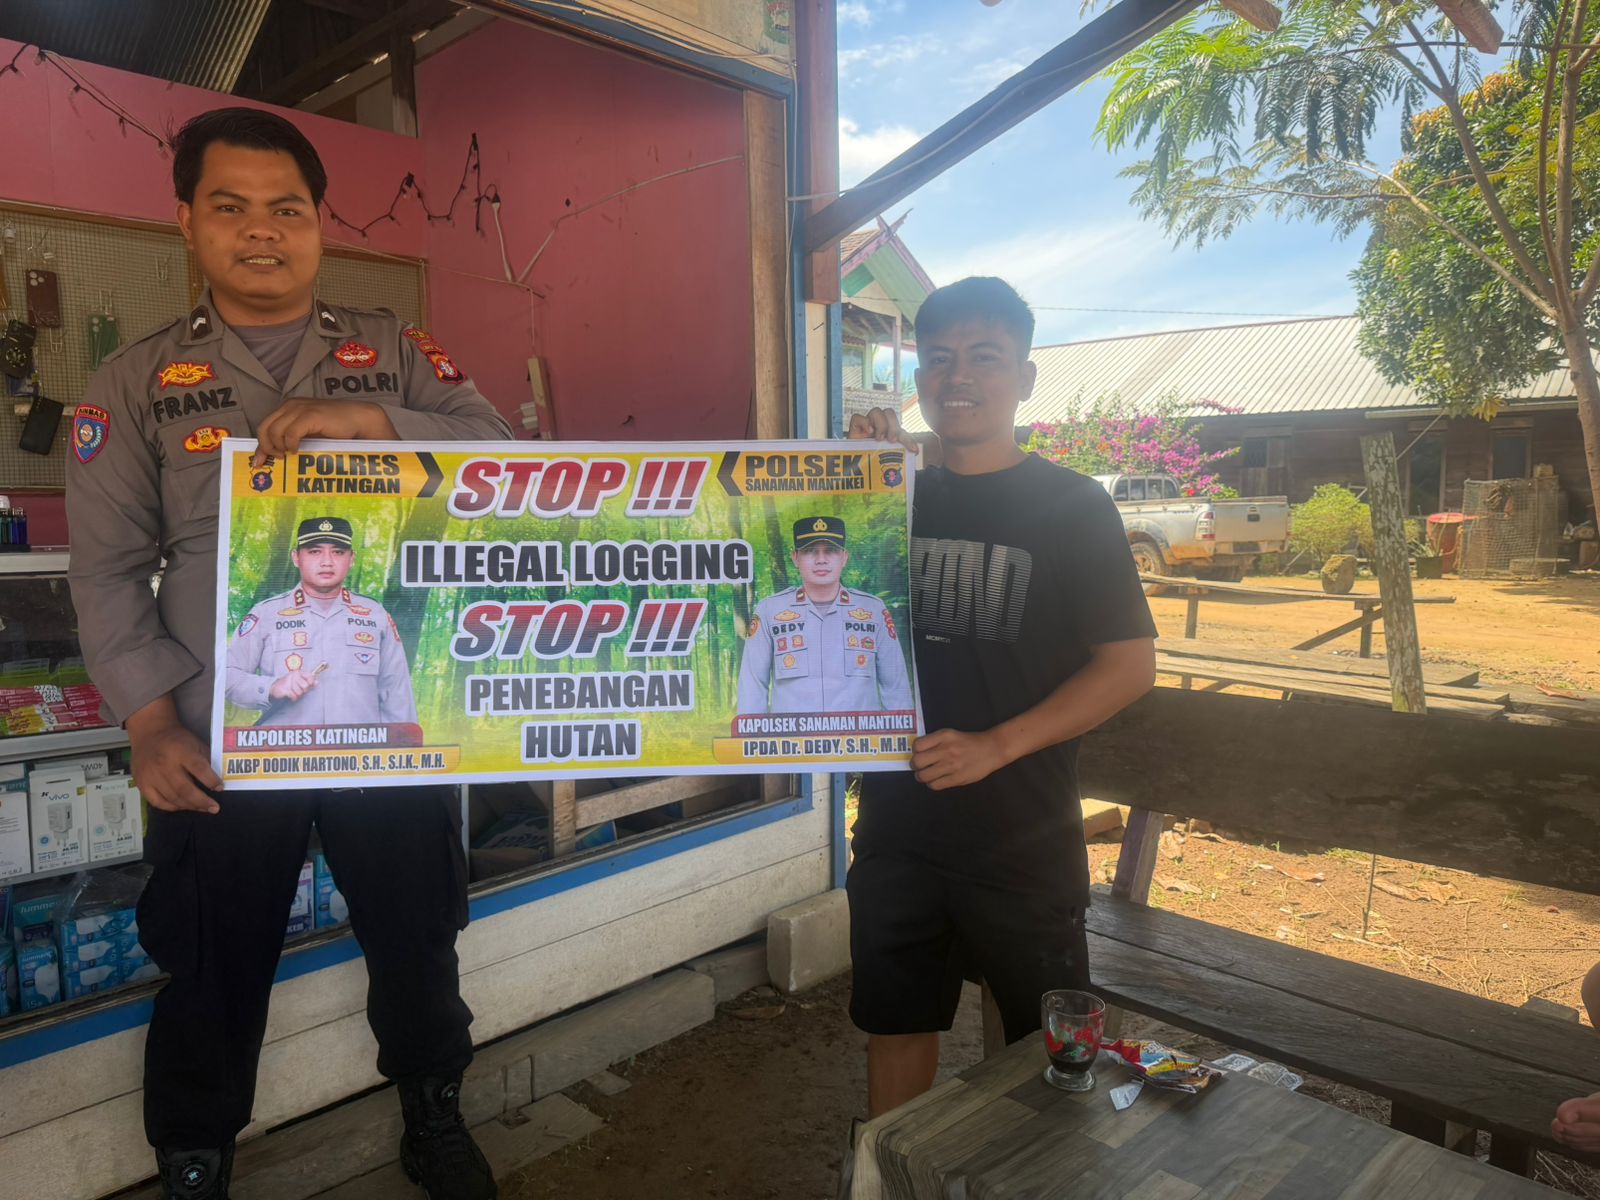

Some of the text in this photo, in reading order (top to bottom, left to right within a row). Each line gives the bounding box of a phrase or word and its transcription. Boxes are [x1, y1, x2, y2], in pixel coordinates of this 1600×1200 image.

[324, 372, 399, 396] POLRI
[153, 387, 237, 423] FRANZ
[297, 454, 400, 477] POLRES
[745, 454, 864, 477] POLSEK
[297, 477, 400, 494] KATINGAN
[450, 458, 708, 516] STOP !!!
[745, 477, 865, 491] SANAMAN MANTIKEI
[404, 543, 749, 584] ILLEGAL LOGGING
[275, 617, 377, 630] DODIK POLRI
[454, 601, 705, 656] STOP !!!
[772, 622, 876, 636] DEDY POLRI
[470, 674, 690, 711] PENEBANGAN
[738, 715, 913, 733] KAPOLSEK SANAMAN MANTIKEI
[237, 728, 388, 747] KAPOLRES KATINGAN
[525, 723, 637, 759] HUTAN
[743, 737, 911, 756] IPDA Dr. DEDY, S.H., M.H.
[227, 758, 260, 774] AKBP
[263, 757, 300, 773] DODIK
[302, 756, 360, 772] HARTONO,
[361, 754, 386, 771] S.H.,
[421, 753, 445, 768] M.H.
